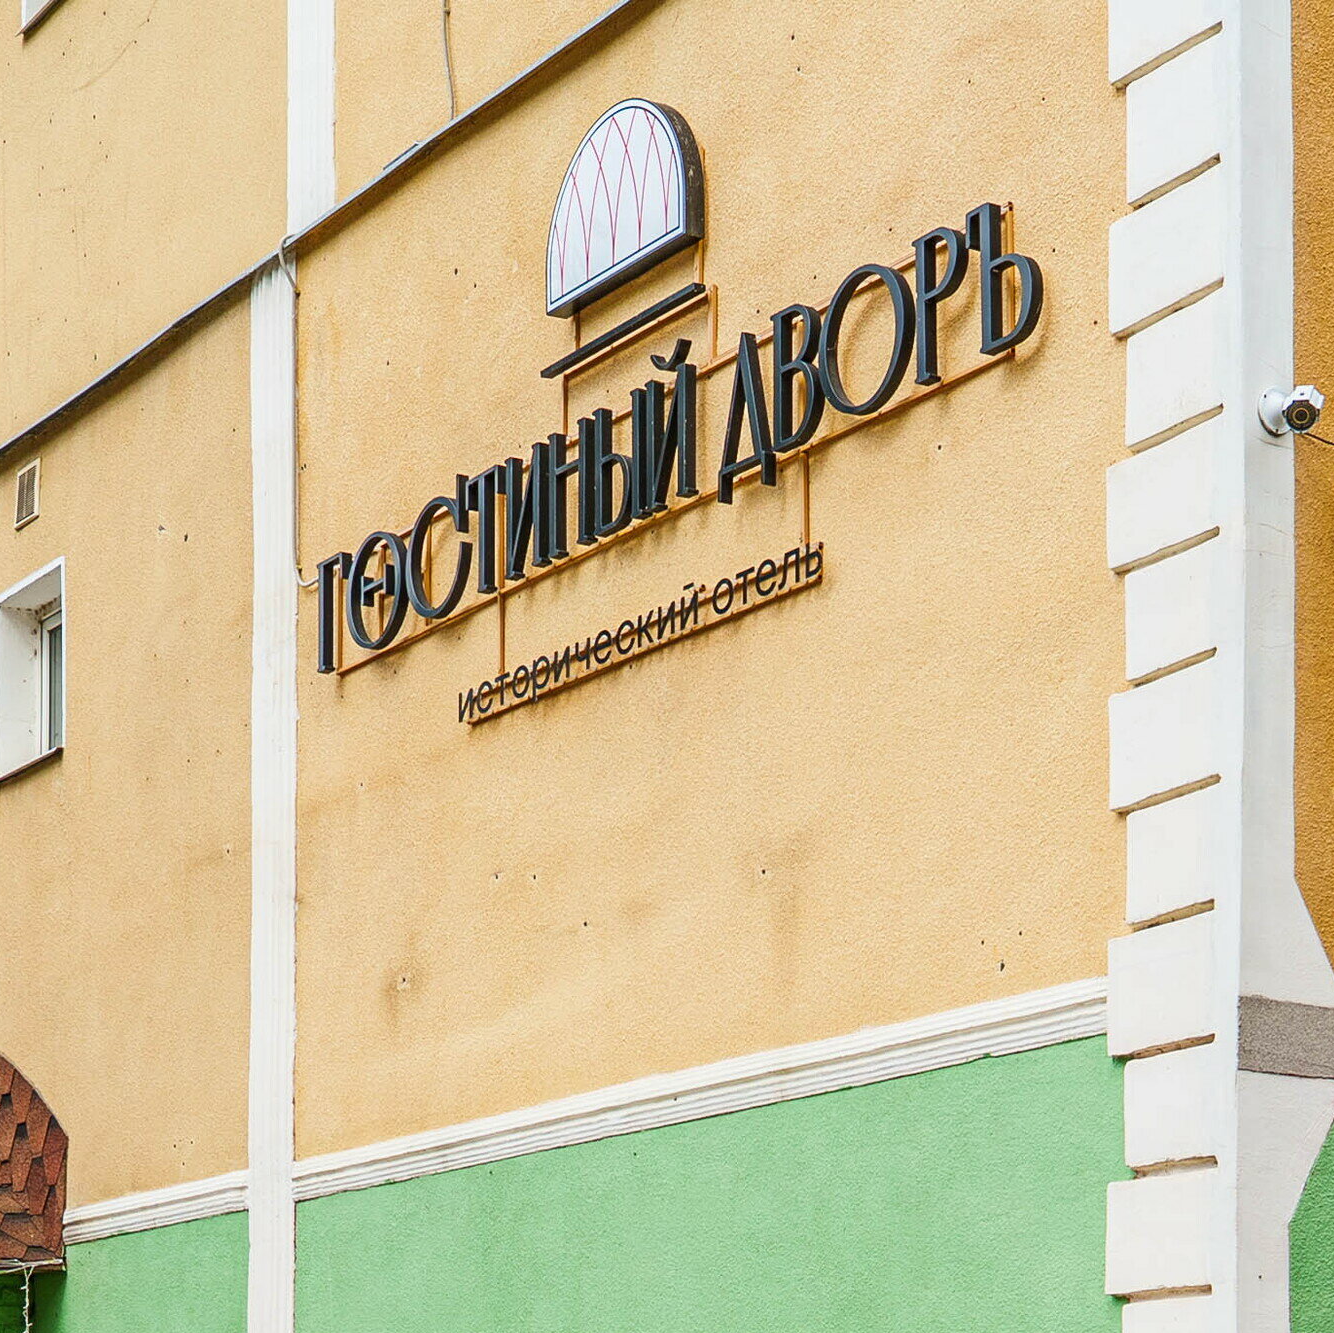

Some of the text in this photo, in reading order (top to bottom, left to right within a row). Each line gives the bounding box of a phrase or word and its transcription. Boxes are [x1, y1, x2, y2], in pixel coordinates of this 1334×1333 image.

[317, 202, 1043, 674] ГОСТИНЫЙ ДВОРЪ
[458, 543, 823, 723] исторический отель
